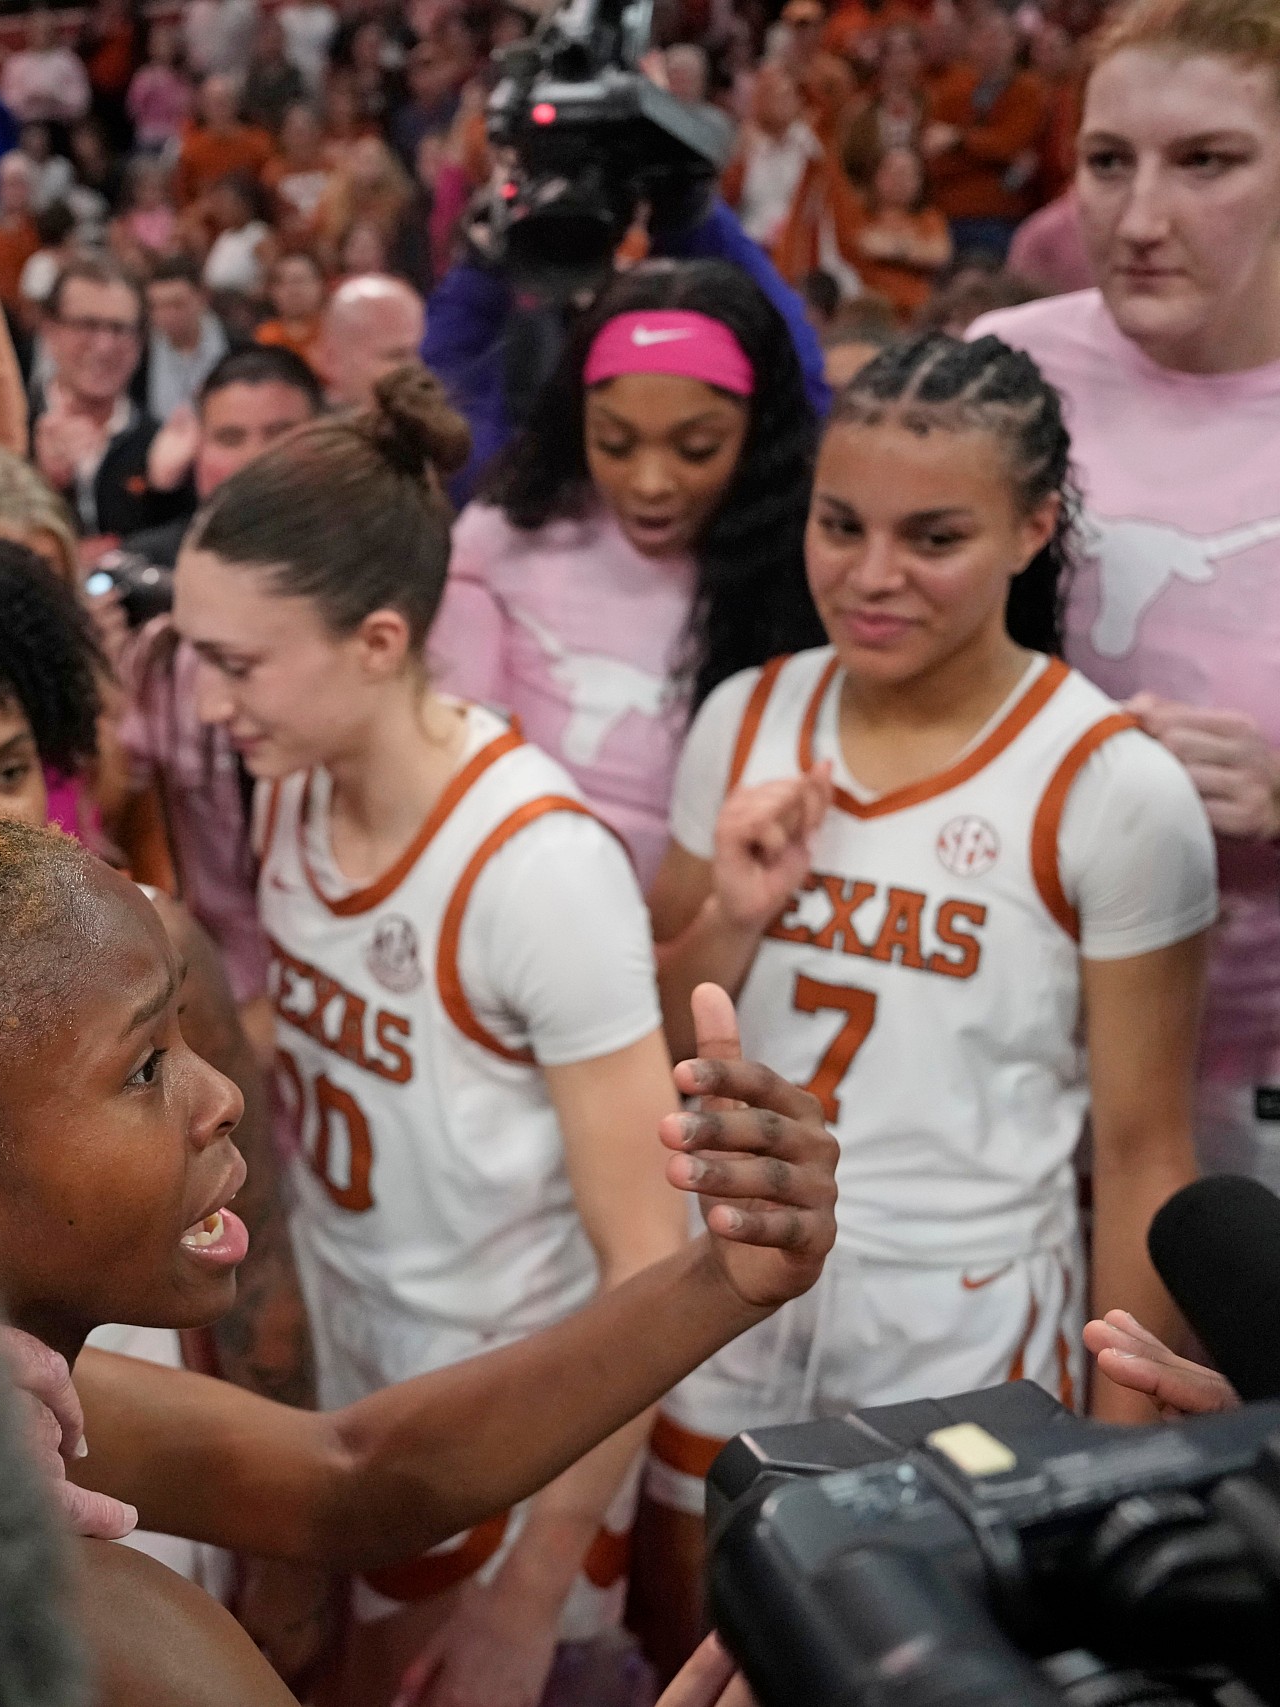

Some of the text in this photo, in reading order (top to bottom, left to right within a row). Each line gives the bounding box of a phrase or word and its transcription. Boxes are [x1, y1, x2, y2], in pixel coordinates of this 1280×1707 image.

[765, 871, 988, 979] EXAS
[267, 937, 413, 1084] EXAS
[792, 973, 877, 1125] 7
